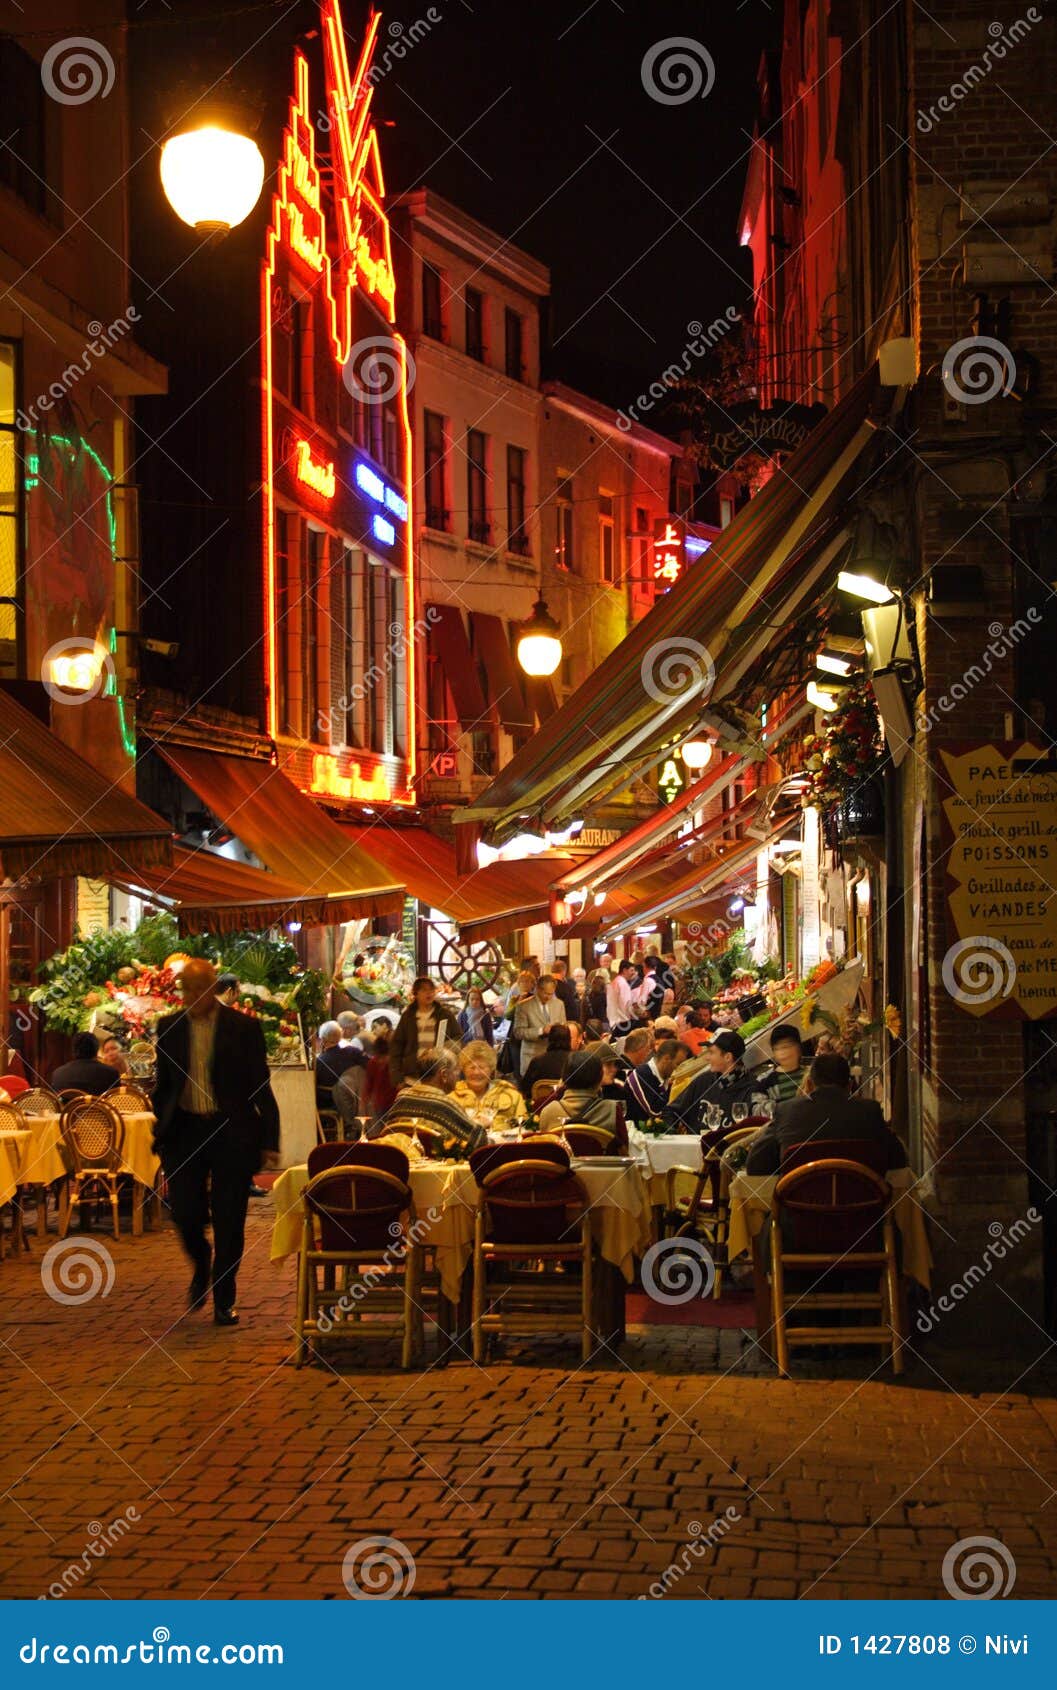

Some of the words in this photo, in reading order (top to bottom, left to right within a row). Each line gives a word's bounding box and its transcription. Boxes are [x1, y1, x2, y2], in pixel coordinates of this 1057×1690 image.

[711, 412, 808, 465] RESTAURA
[654, 524, 681, 583] 上海
[440, 757, 454, 775] P
[969, 766, 1045, 780] PAEL
[1008, 820, 1041, 840] grill
[968, 878, 1036, 894] Grillades
[1036, 958, 1057, 973] ME
